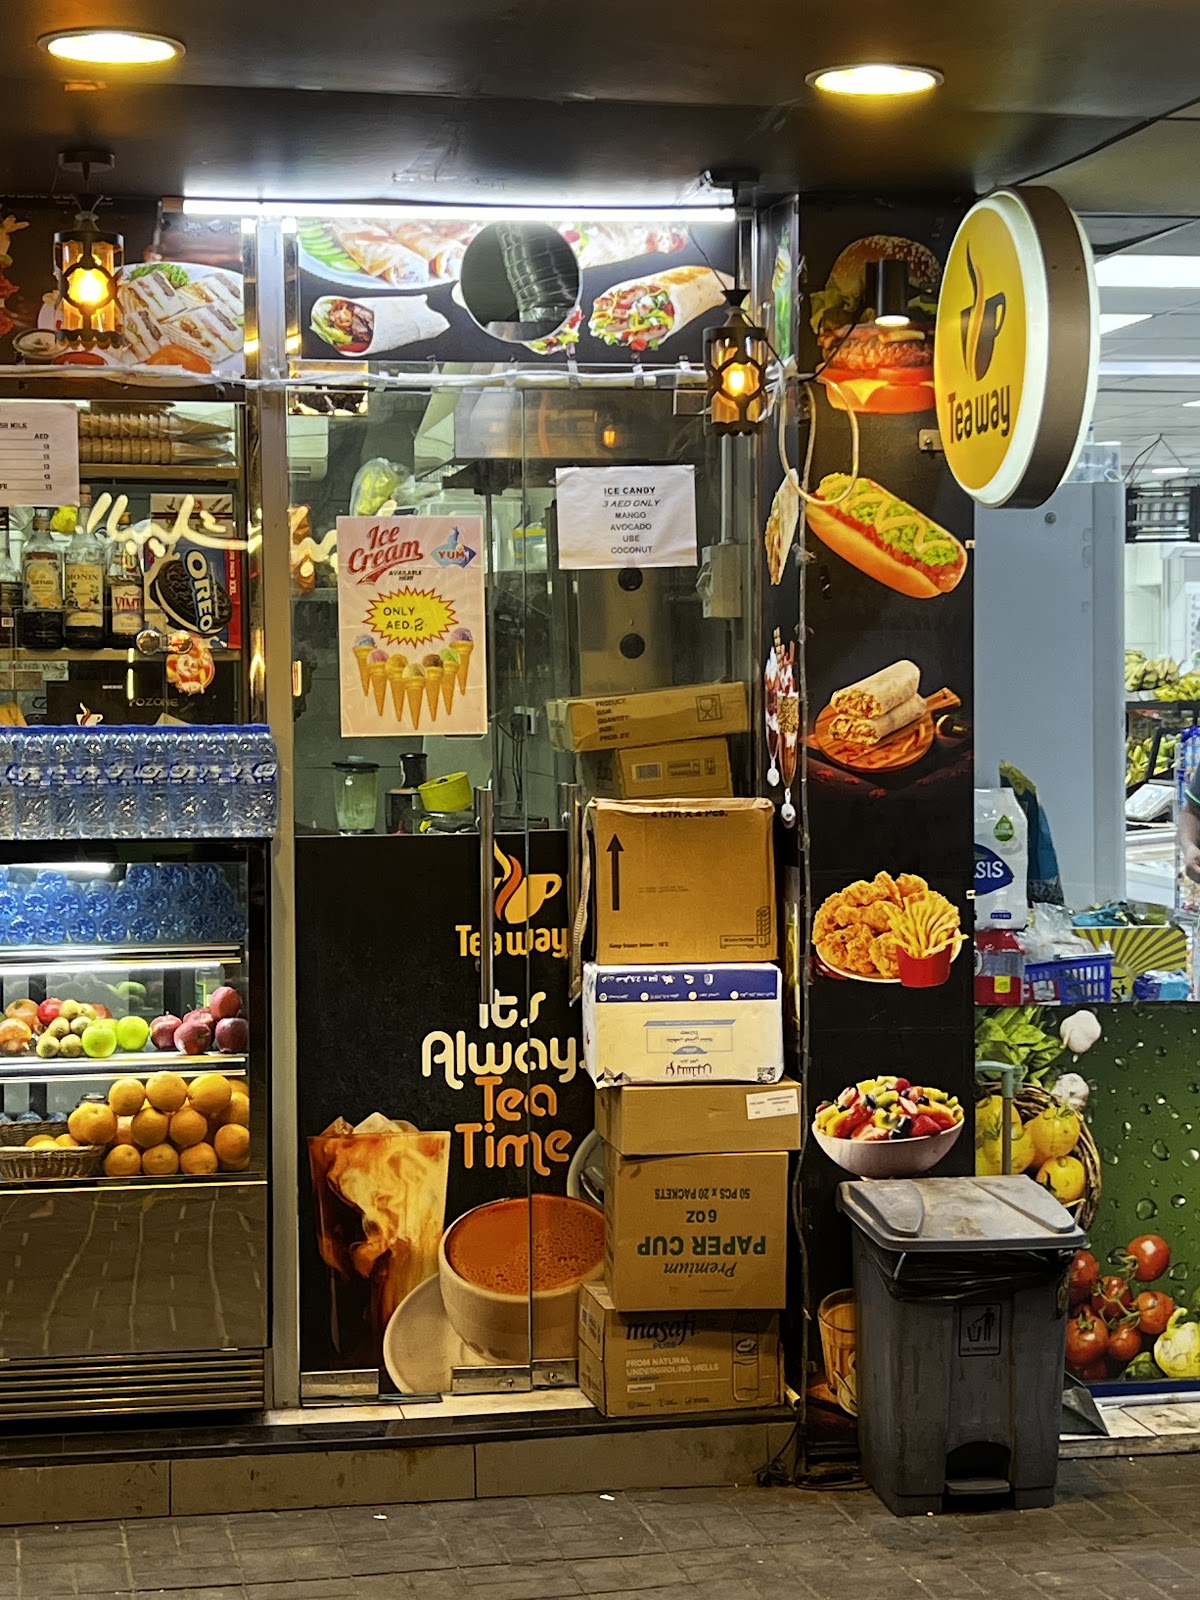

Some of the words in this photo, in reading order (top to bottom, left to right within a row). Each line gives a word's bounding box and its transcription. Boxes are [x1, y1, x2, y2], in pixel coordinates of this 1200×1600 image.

[947, 384, 1011, 444] Teaway
[604, 487, 620, 495] ICE
[622, 486, 656, 495] CANDY
[602, 500, 609, 508] 3
[610, 500, 631, 508] AED
[633, 499, 661, 507] ONLY
[615, 511, 647, 519] MANGO
[610, 523, 652, 531] AVOCADO
[368, 524, 400, 550] Ice
[622, 535, 640, 543] UBE
[611, 546, 653, 554] COCONUT
[348, 539, 424, 575] Cream
[186, 549, 213, 632] OREO
[383, 606, 416, 617] ONLY
[974, 860, 1004, 879] SIS
[422, 1030, 587, 1090] Alway
[474, 1075, 558, 1122] Tea
[454, 1122, 573, 1177] Time
[655, 1188, 697, 1200] PACKETS
[698, 1188, 709, 1199] 20
[720, 1188, 738, 1199] PCS
[739, 1188, 751, 1199] 50
[637, 1235, 685, 1256] CUP
[691, 1235, 767, 1256] PAPER
[663, 1261, 738, 1278] Premium
[626, 1312, 697, 1346] masafi
[626, 1358, 651, 1367] FROM
[652, 1356, 690, 1365] NATURAL
[626, 1365, 691, 1376] UNDERGROUND
[693, 1363, 719, 1372] WELLS
